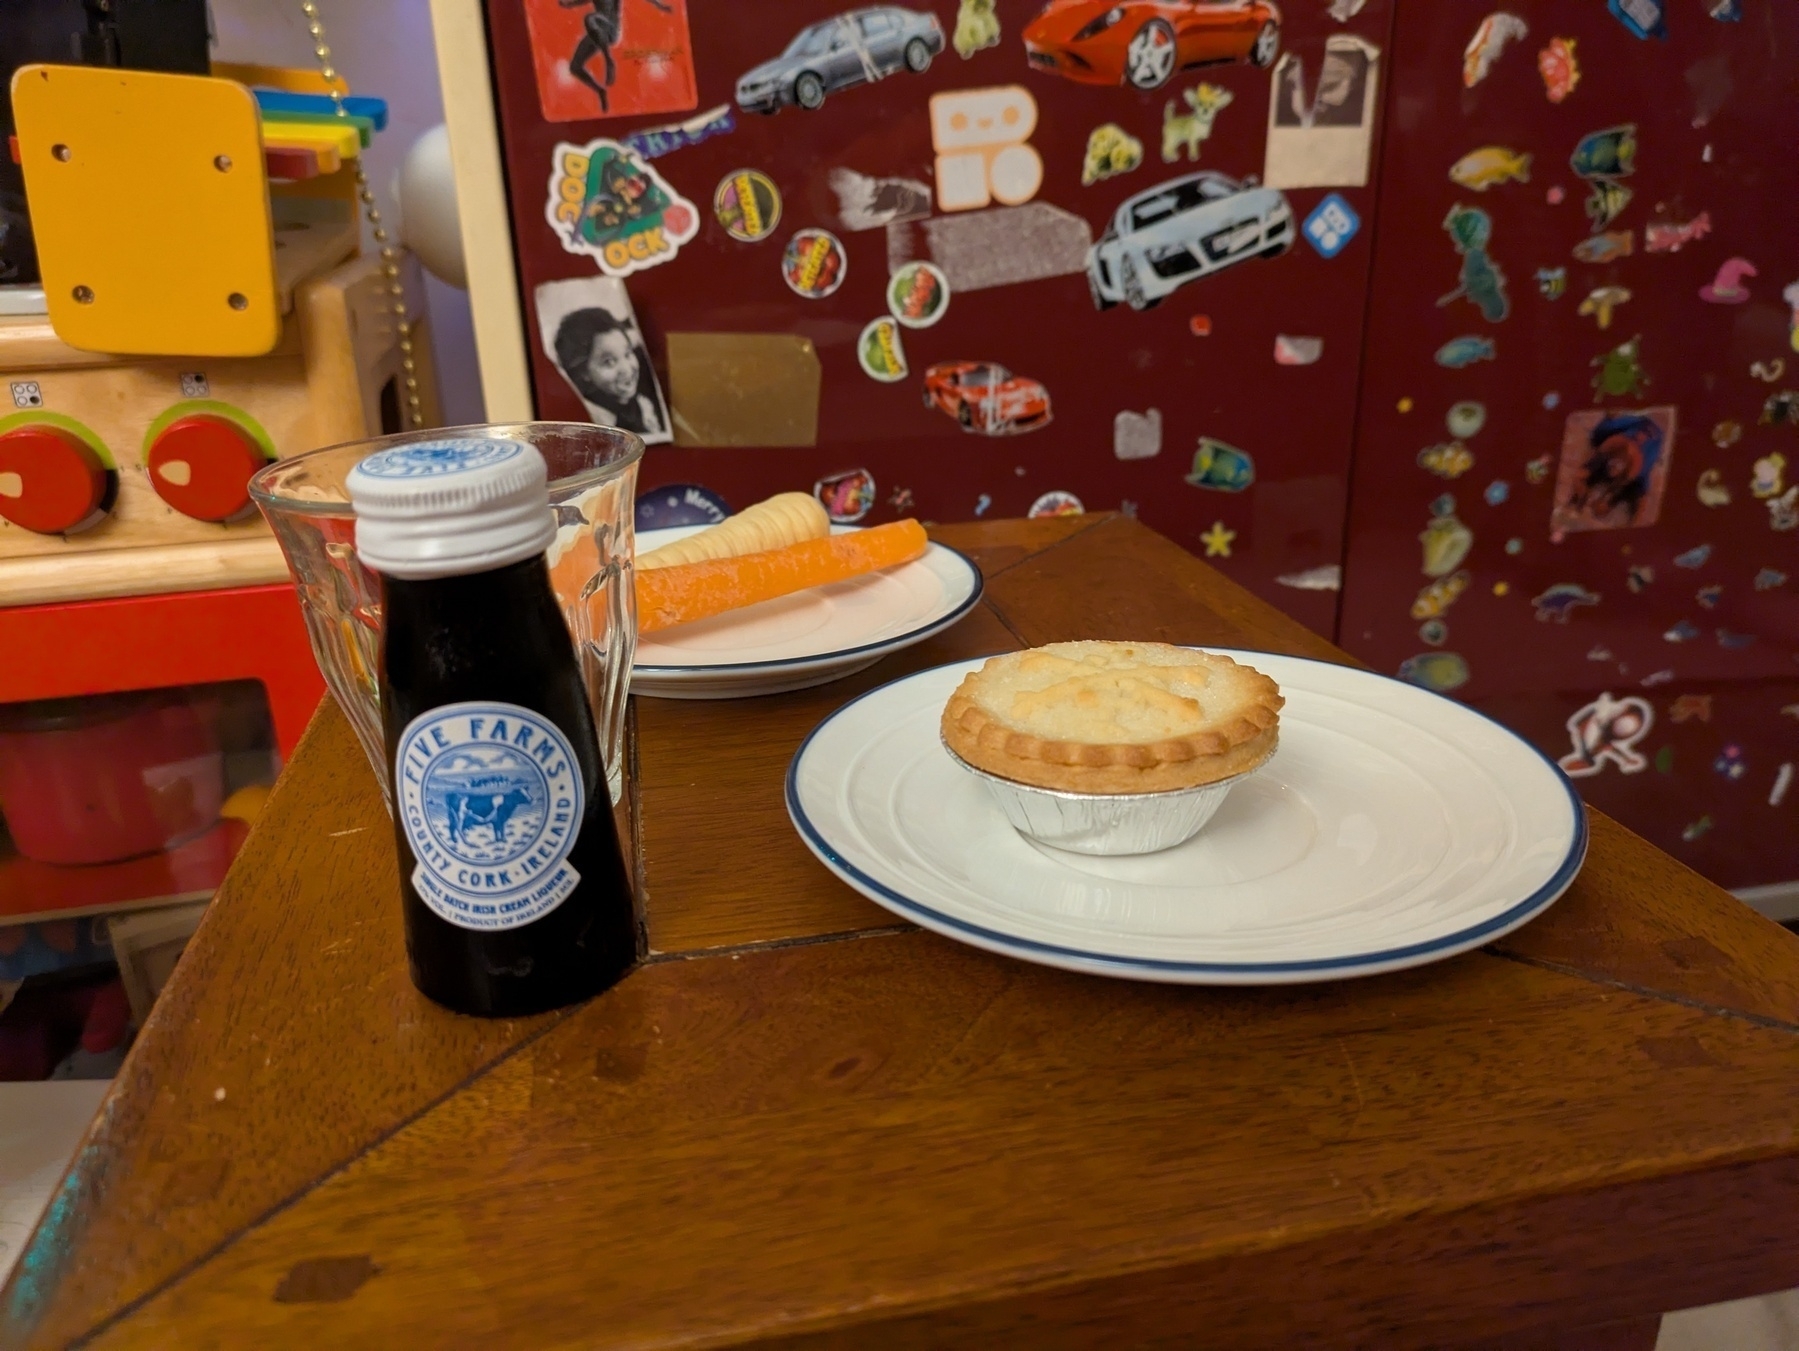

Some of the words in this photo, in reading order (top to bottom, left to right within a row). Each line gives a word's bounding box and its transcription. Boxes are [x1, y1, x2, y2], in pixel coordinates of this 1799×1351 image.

[555, 153, 591, 225] DOC
[604, 226, 670, 269] OCK
[684, 487, 726, 523] Merry
[405, 726, 450, 785] FIVE
[469, 718, 567, 780] FARMS
[408, 805, 453, 872] COUNTY
[458, 868, 513, 888] CORK
[520, 798, 571, 875] IRELAND
[444, 893, 469, 912] BATCH
[472, 903, 497, 914] IRISH
[499, 896, 531, 913] CREAM
[530, 868, 568, 902] LIQUEUR
[453, 911, 498, 926] PRODUCT
[501, 916, 514, 925] OF
[516, 896, 556, 921] IRELAND
